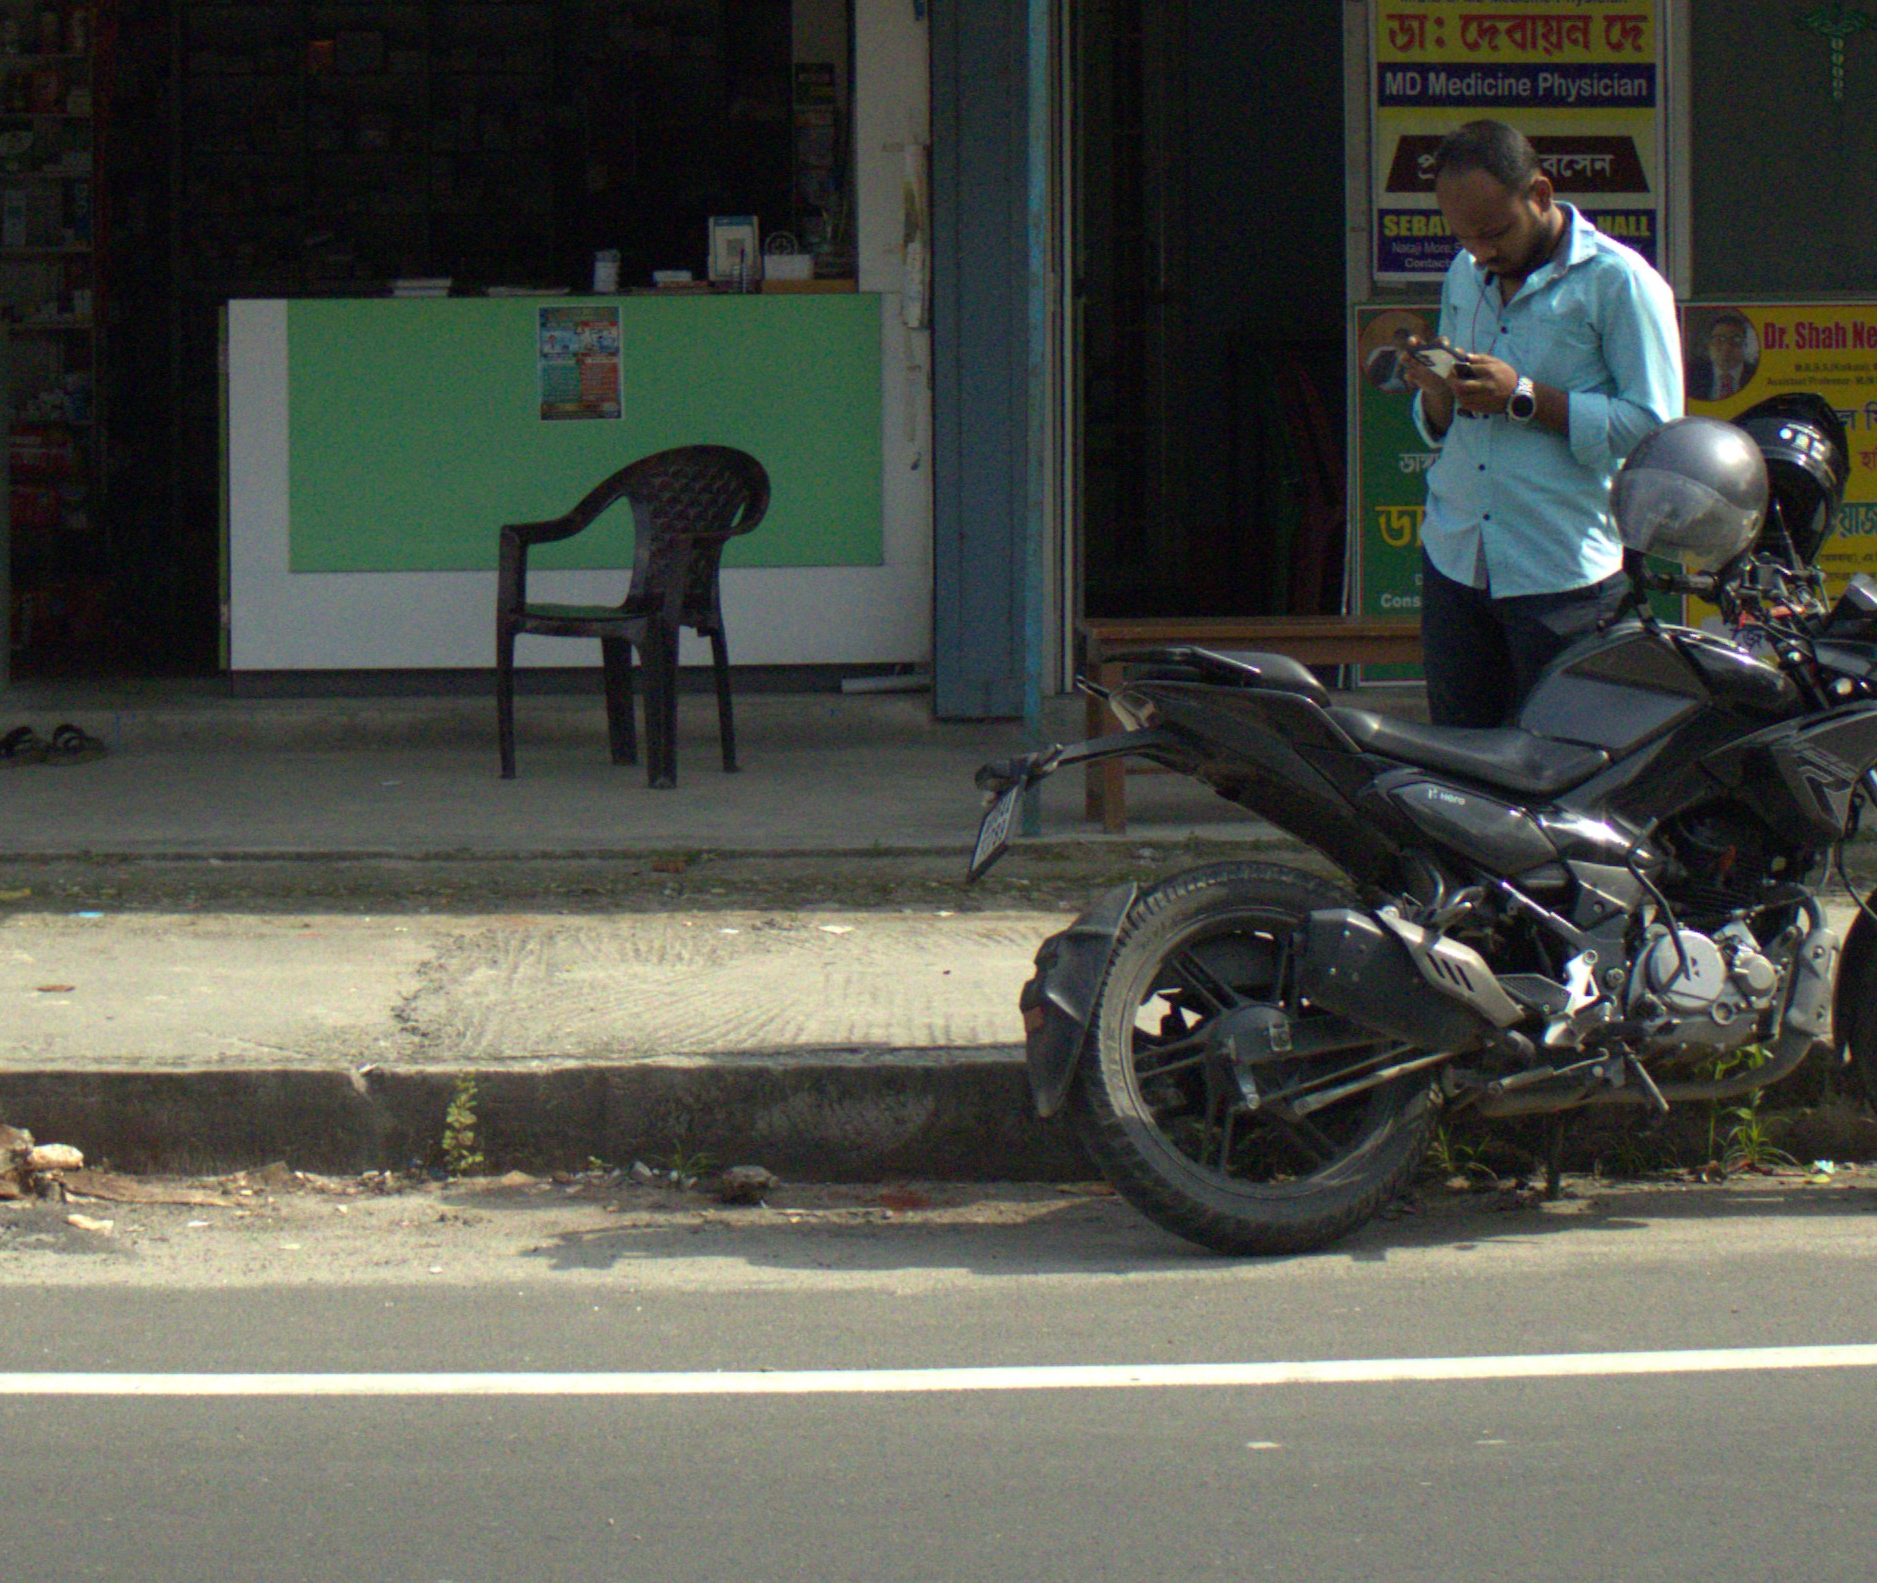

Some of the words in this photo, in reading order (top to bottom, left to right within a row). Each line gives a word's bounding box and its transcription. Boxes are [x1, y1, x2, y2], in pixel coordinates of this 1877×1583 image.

[1459, 13, 1592, 56] দেবায়ন
[1604, 13, 1650, 53] দে
[1384, 71, 1422, 96] MD
[1428, 71, 1532, 97] Medicine
[1537, 71, 1648, 102] Physician
[1764, 321, 1789, 349] Dr.
[1795, 320, 1847, 349] Shah
